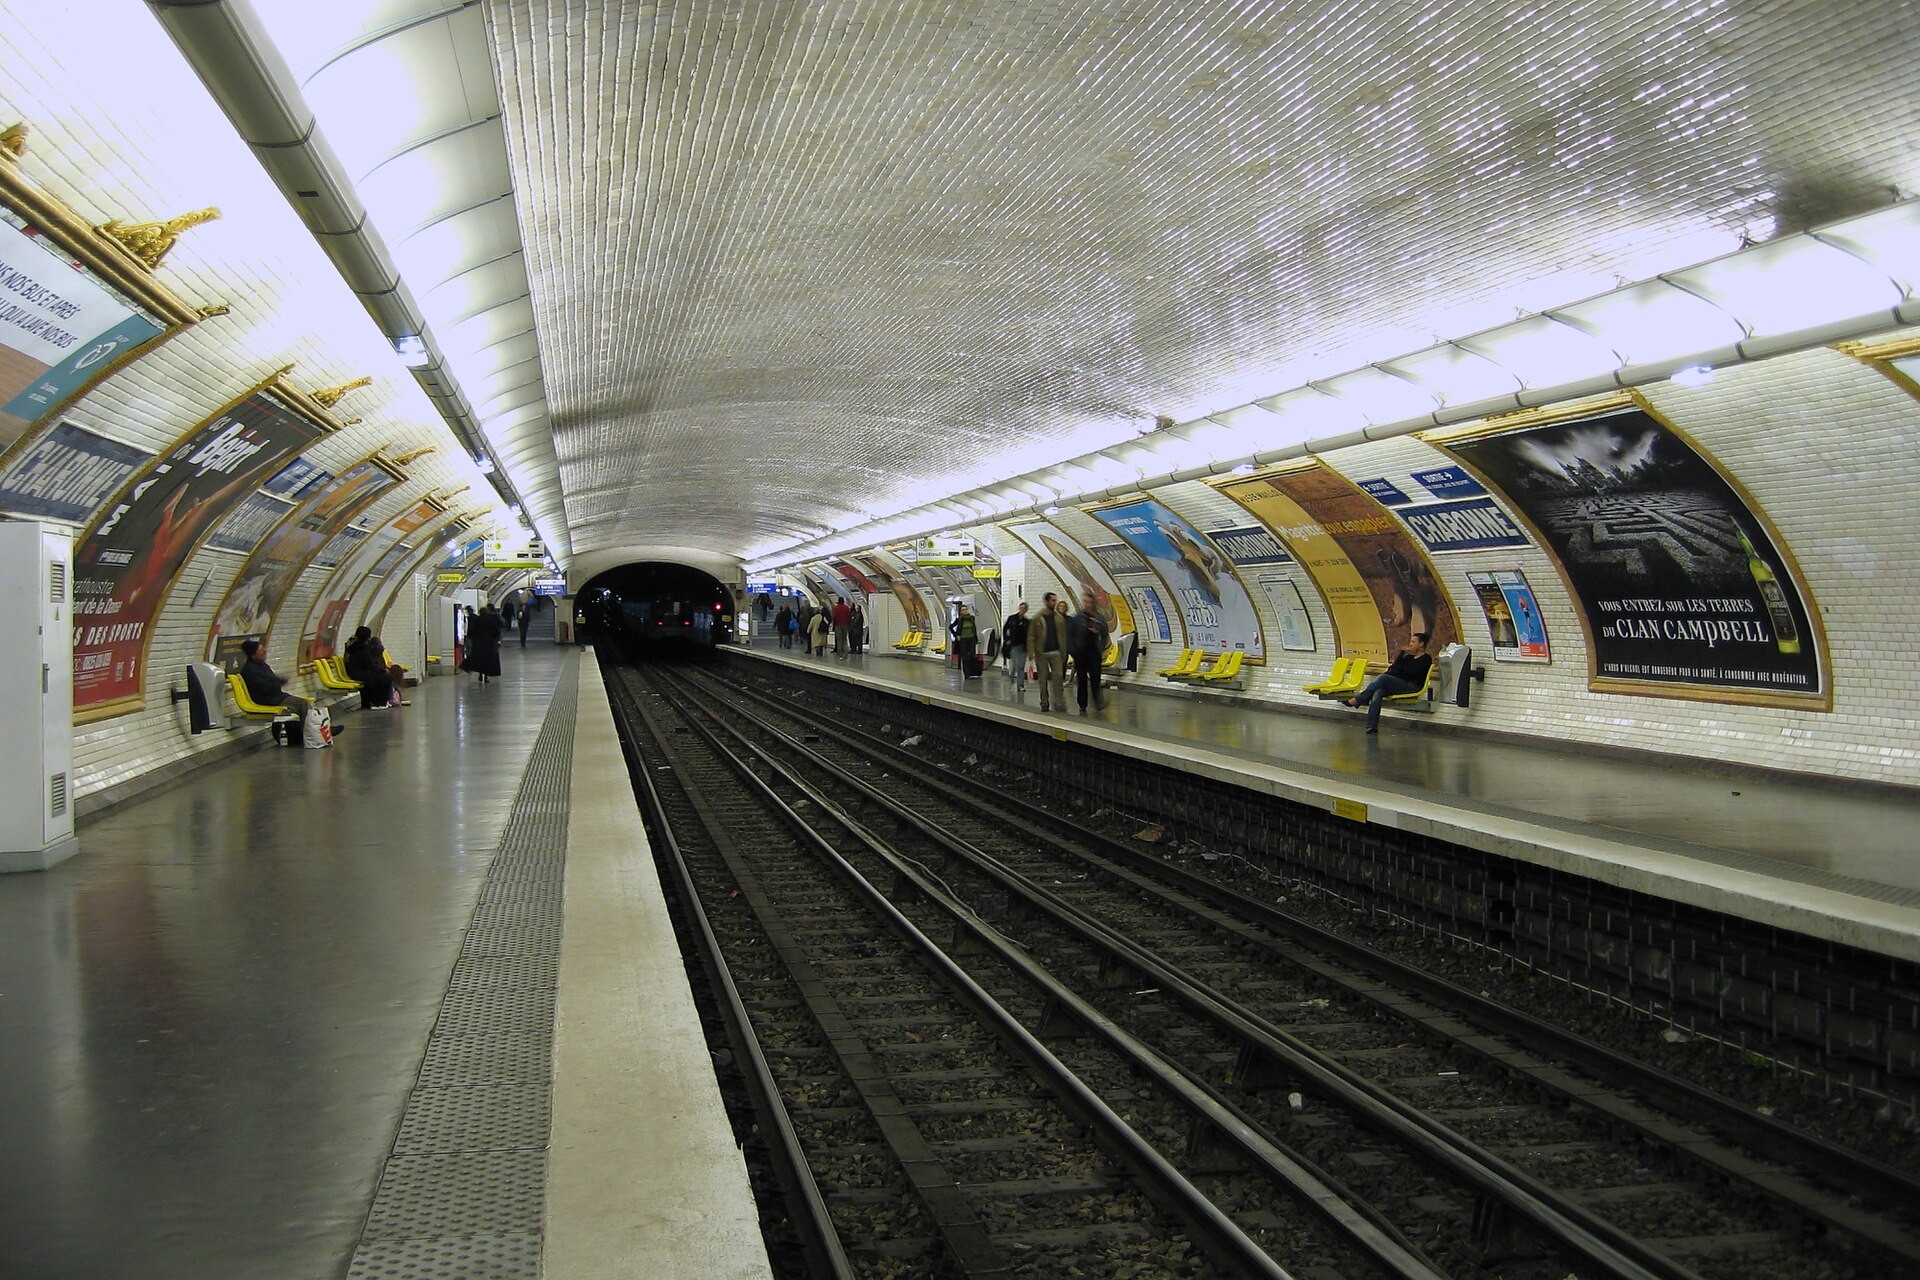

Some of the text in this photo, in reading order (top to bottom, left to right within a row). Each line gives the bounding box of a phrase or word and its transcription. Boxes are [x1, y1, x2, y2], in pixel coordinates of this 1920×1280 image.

[1, 272, 33, 292] NOS
[20, 283, 50, 302] BUS
[37, 293, 60, 308] ET
[38, 325, 65, 341] NOS
[53, 332, 78, 348] BUS
[2, 440, 134, 508] CHARONNE
[1408, 507, 1520, 543] CHARONNE
[1216, 533, 1286, 559] CHARONNE
[1598, 598, 1754, 612] VOUS ENTREZ SUR LES TERRES
[86, 626, 109, 646] DES
[108, 622, 145, 642] SPORTS
[1602, 626, 1616, 638] DU
[1616, 618, 1661, 640] CLAN
